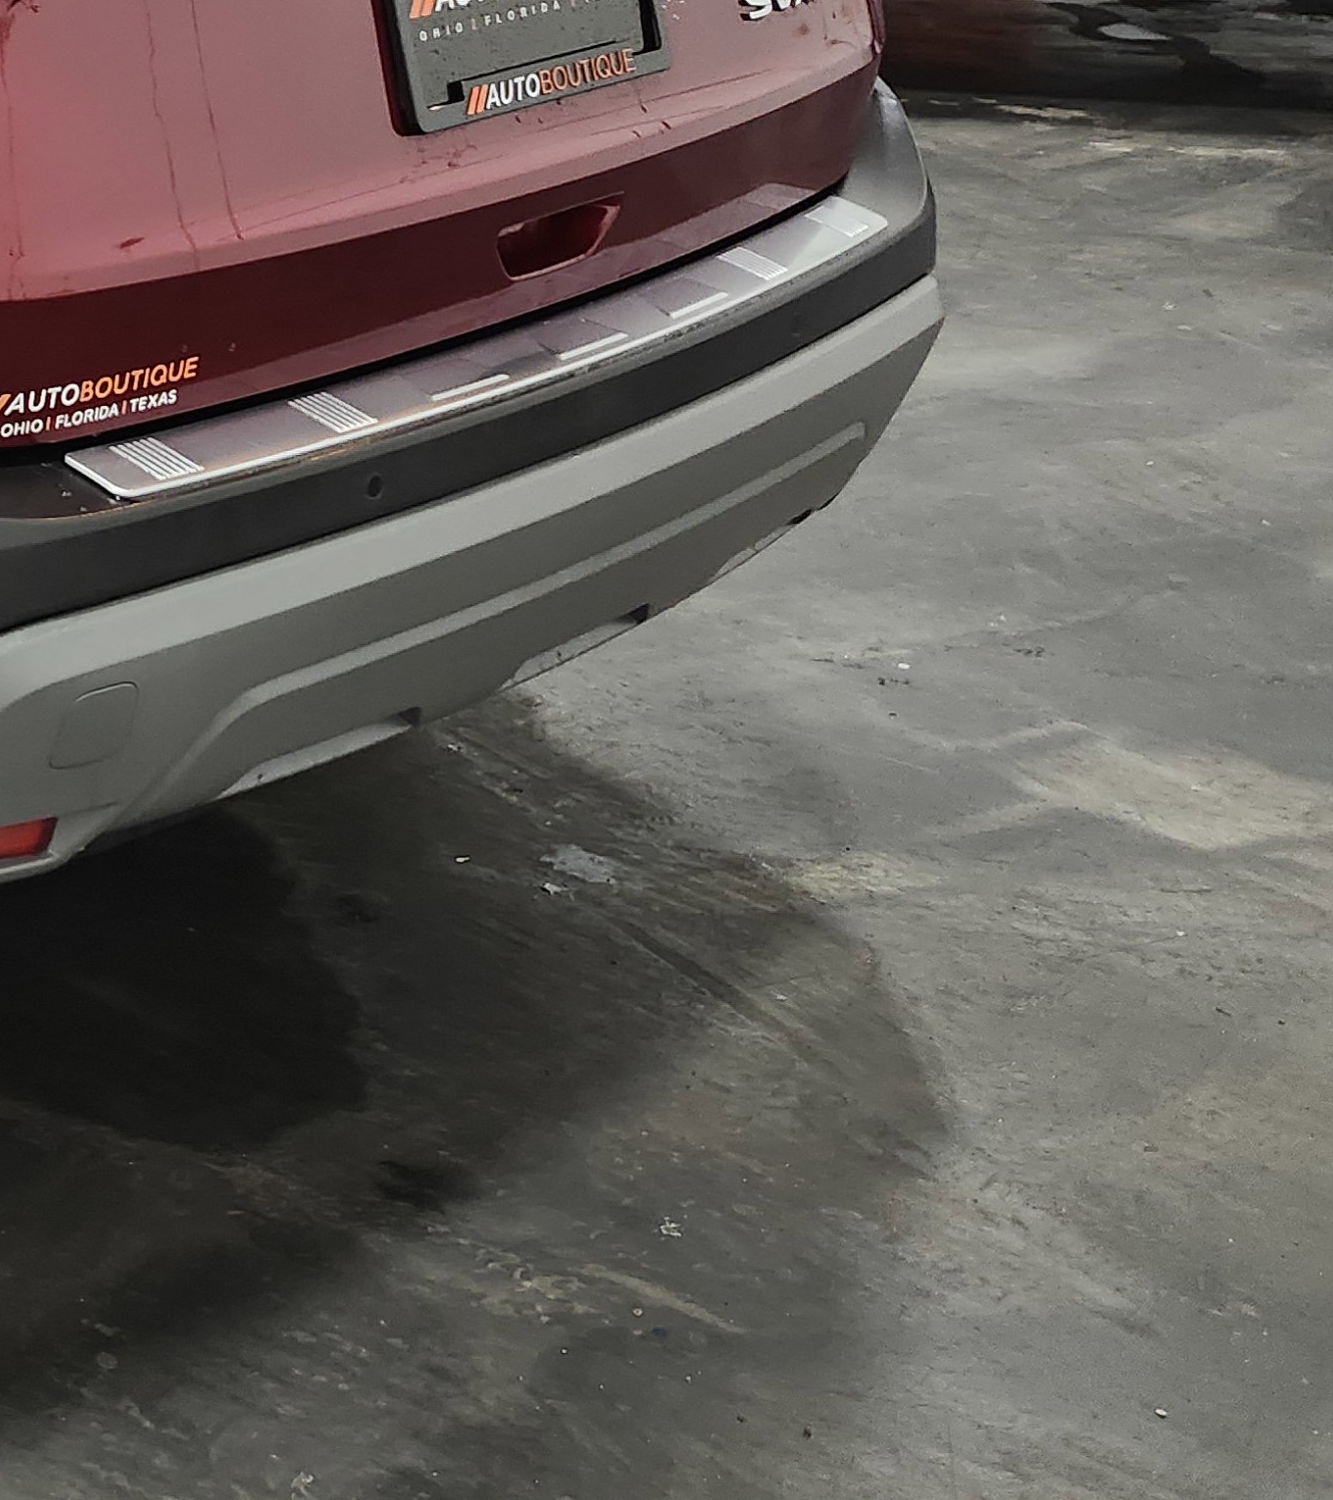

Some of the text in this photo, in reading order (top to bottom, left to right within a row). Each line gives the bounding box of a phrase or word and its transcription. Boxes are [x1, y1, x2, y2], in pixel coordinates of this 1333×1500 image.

[418, 21, 464, 42] OHIO
[484, 0, 562, 27] FLORIDA
[0, 389, 178, 438] OHIO FLORIDA TEXAS
